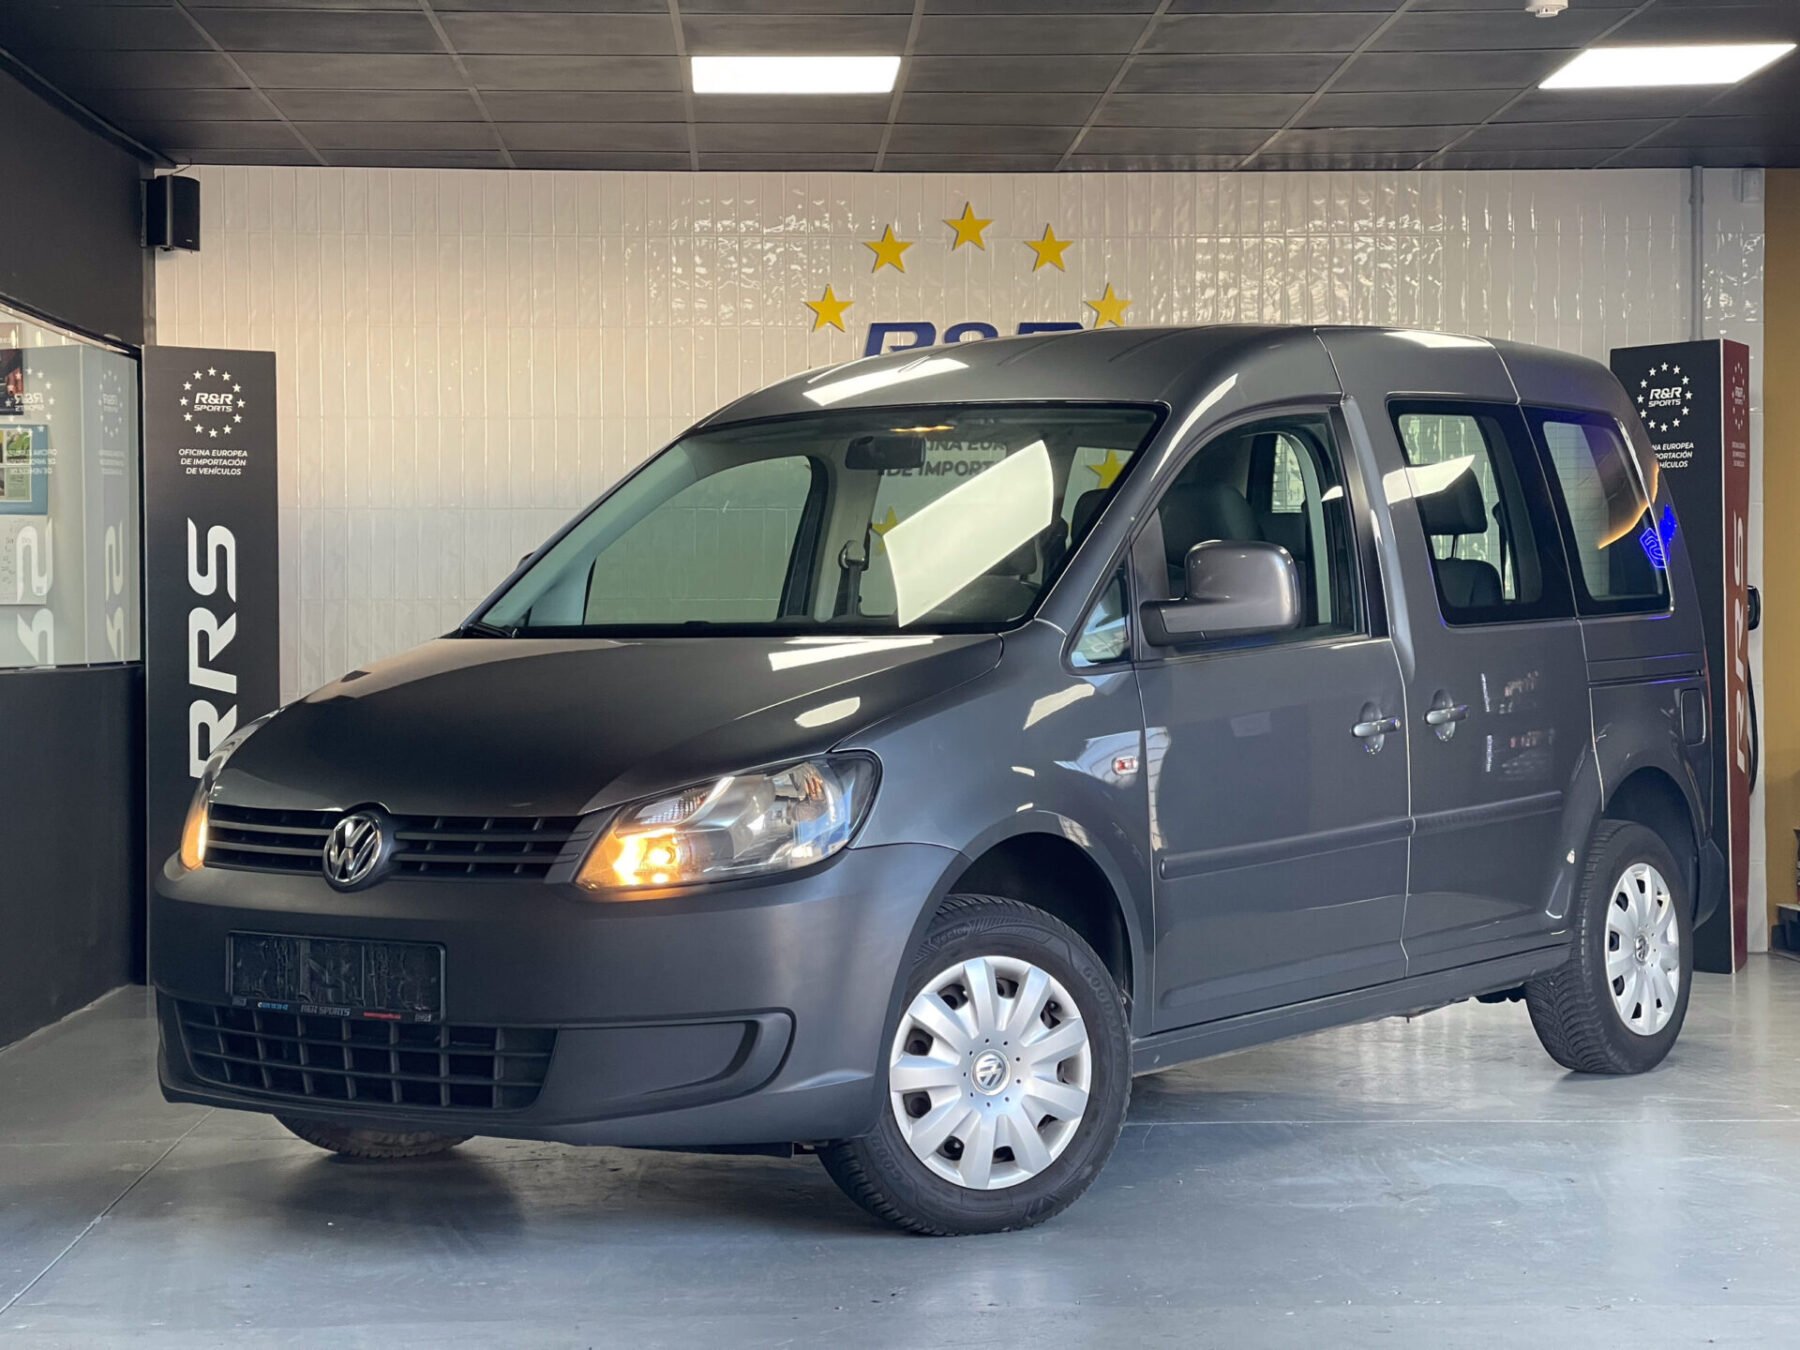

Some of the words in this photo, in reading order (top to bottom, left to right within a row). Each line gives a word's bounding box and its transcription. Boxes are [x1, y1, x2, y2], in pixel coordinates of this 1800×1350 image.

[1650, 387, 1683, 400] R&R
[195, 392, 233, 405] R&R
[1648, 398, 1682, 407] SPORTS
[193, 404, 233, 413] SPORTS
[1662, 442, 1694, 451] EUROPEA
[178, 448, 210, 456] OFICINA
[211, 449, 248, 457] EUROPEA
[193, 457, 247, 466] IMPORTACIÓN
[185, 467, 197, 475] DE
[198, 466, 242, 476] VEHÍCULOS
[1733, 510, 1747, 773] RRS
[187, 517, 238, 779] RRS
